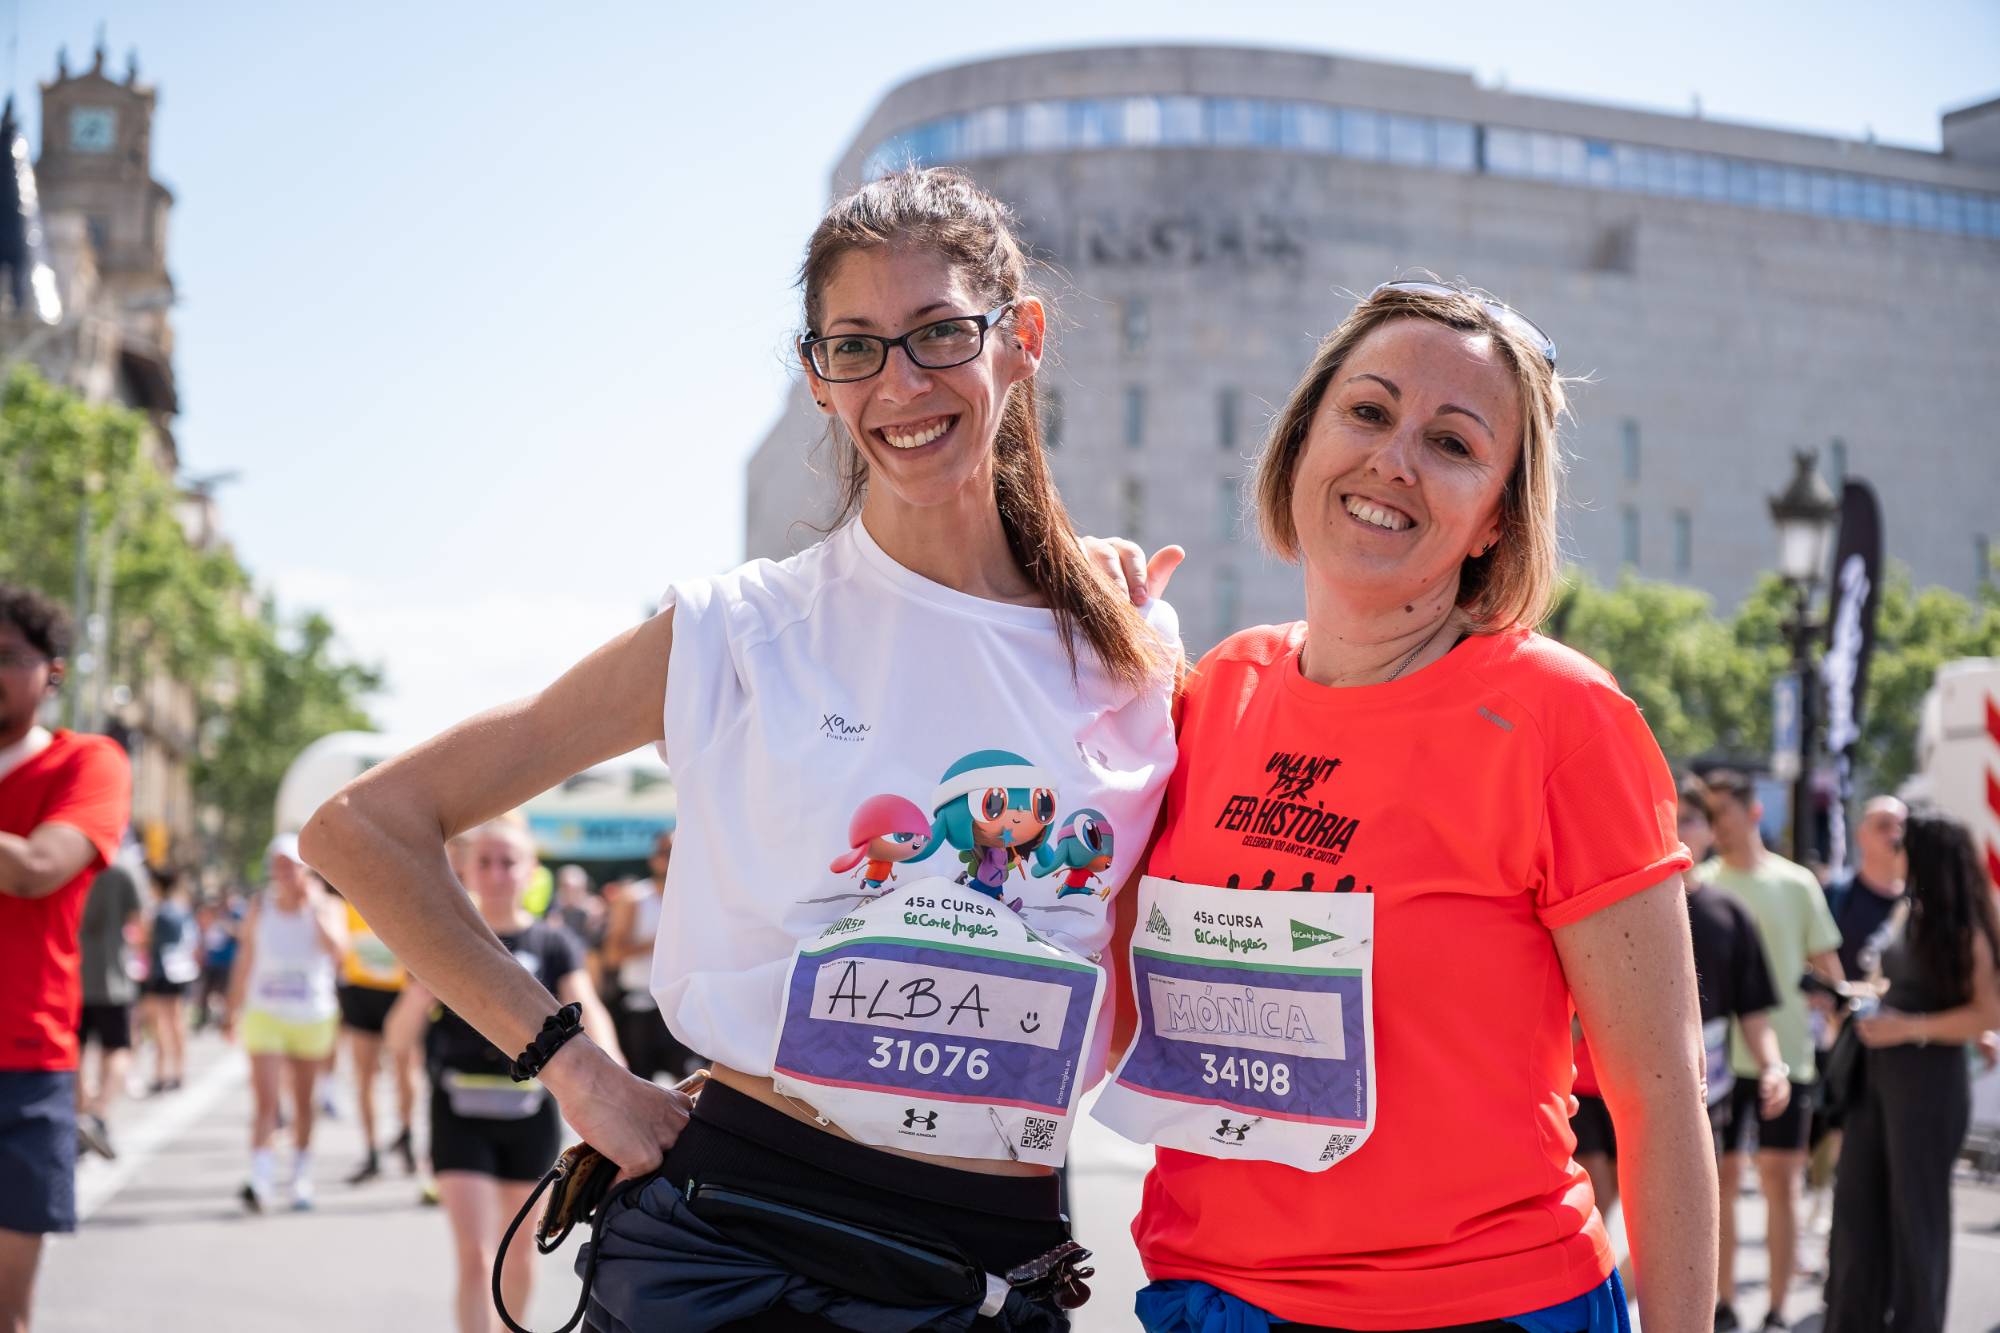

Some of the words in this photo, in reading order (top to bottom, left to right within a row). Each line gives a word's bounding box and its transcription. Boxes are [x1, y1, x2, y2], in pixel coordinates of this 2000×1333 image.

[1215, 795, 1258, 832] FER
[1251, 799, 1360, 852] HISTÒRIA
[1242, 835, 1273, 849] CELEBREM
[1273, 840, 1286, 852] 100
[1284, 843, 1305, 857] ANYS
[1303, 848, 1316, 858] DE
[1314, 849, 1343, 865] CIUTAT
[904, 896, 935, 909] 45a
[941, 898, 996, 918] CURSA
[1193, 910, 1214, 924] 45a
[1217, 913, 1264, 929] CURSA
[904, 912, 918, 925] El
[918, 913, 951, 930] Corte
[952, 914, 998, 938] Inglés
[1195, 928, 1205, 943] El
[1204, 930, 1229, 947] Corte
[1228, 930, 1268, 954] Inglés
[828, 960, 990, 1028] ALBA
[868, 1036, 991, 1081] 31076
[1200, 1052, 1290, 1096] 34198
